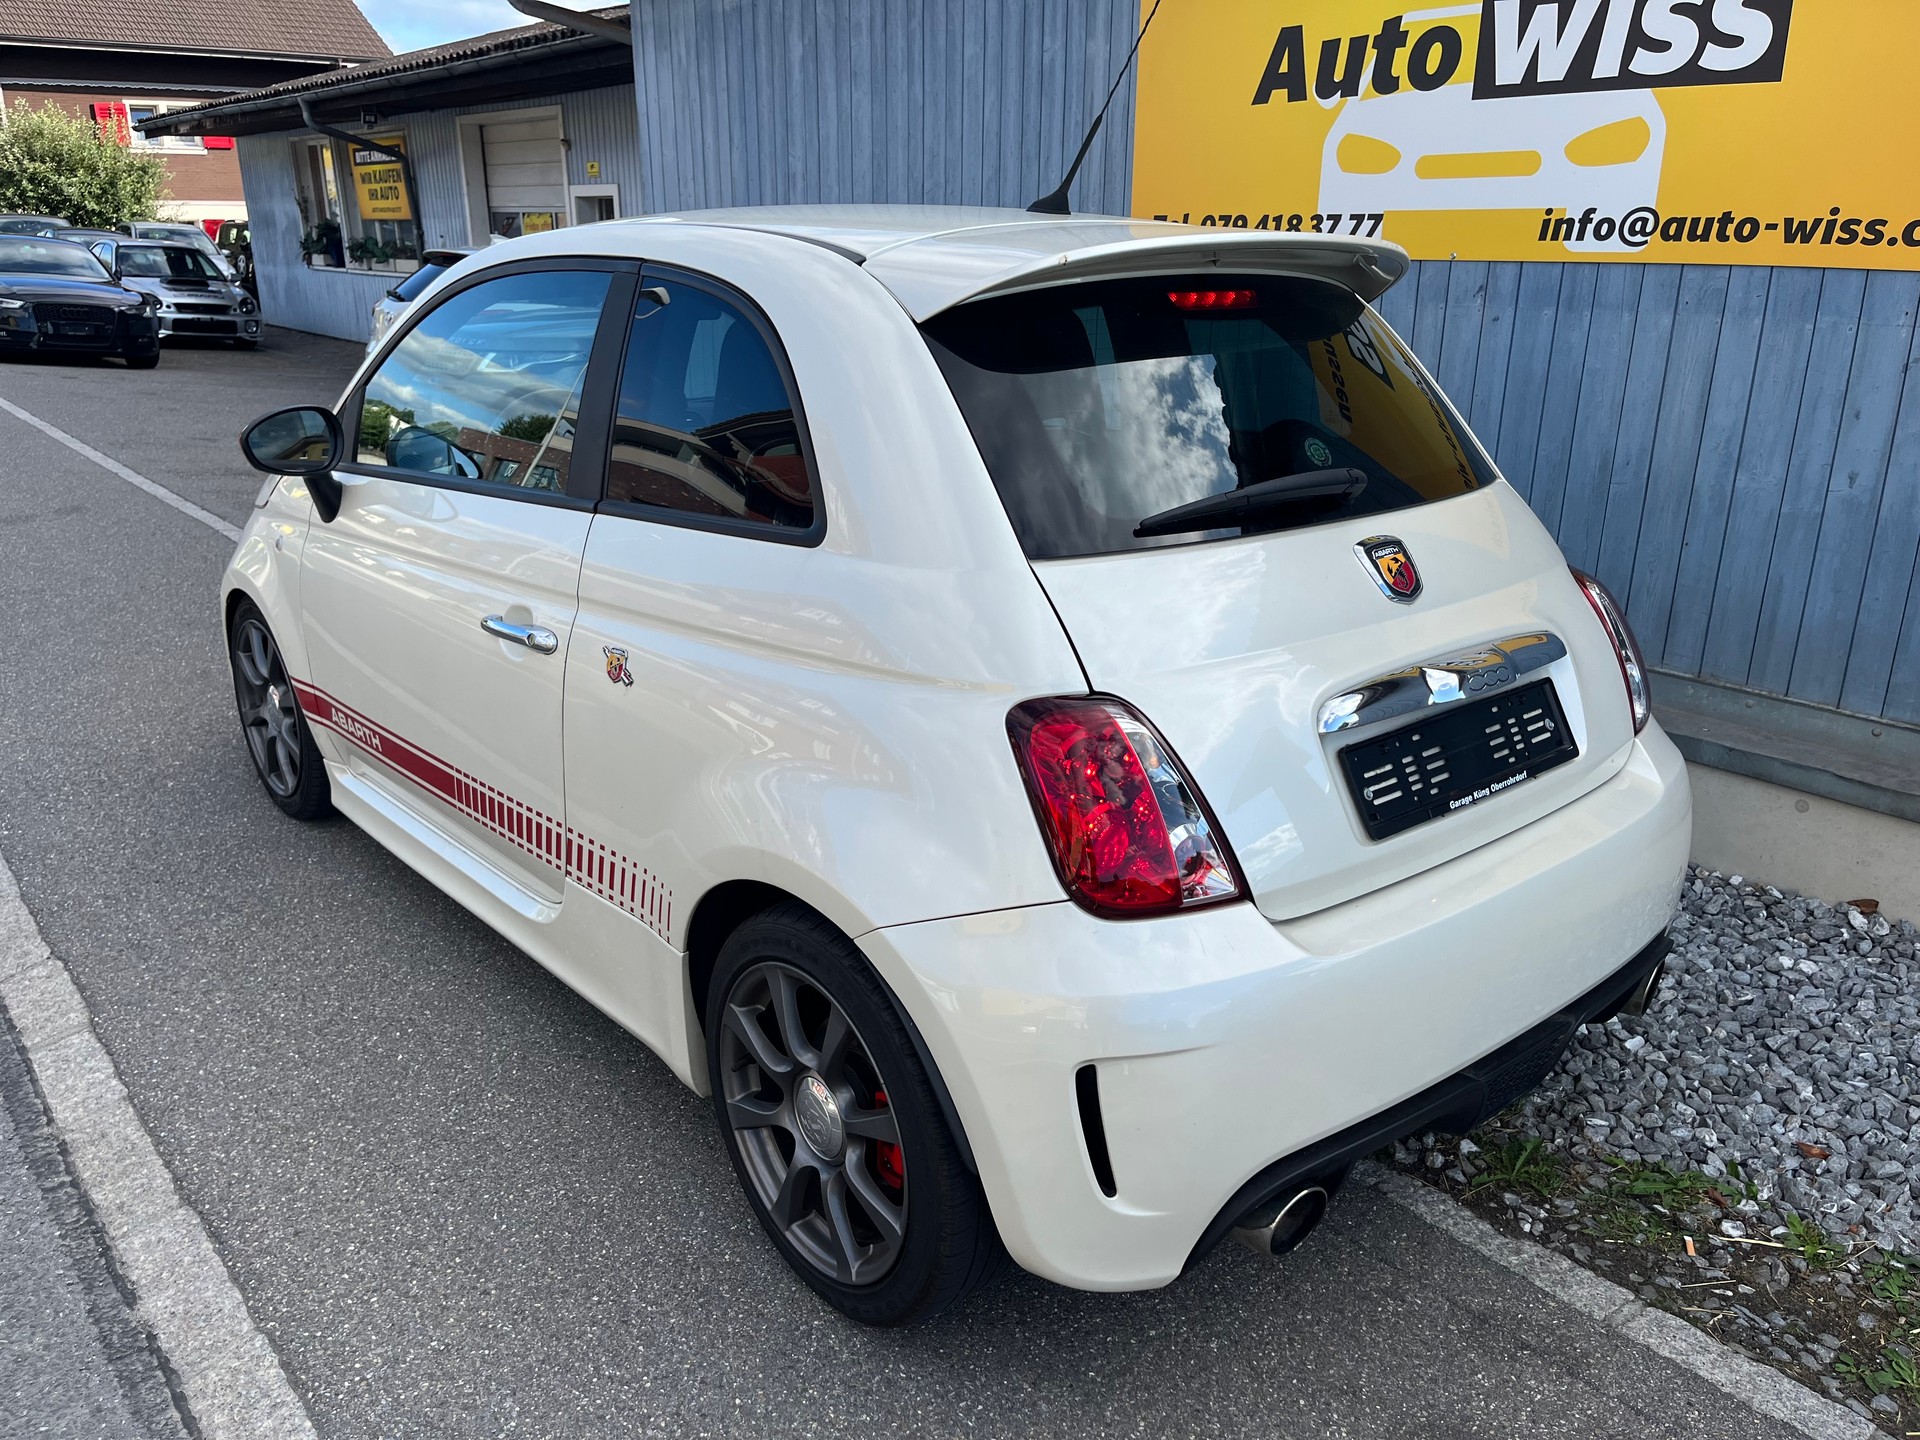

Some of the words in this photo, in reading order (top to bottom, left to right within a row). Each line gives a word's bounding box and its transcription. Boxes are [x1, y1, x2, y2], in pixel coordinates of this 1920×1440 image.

[1251, 15, 1463, 106] Auto
[372, 168, 402, 184] KAUFEN
[380, 186, 400, 200] AUTO
[1254, 214, 1304, 231] 418
[1309, 213, 1343, 233] 37
[1349, 213, 1385, 238] 77
[1375, 547, 1399, 558] ABARTH
[331, 706, 383, 752] ABARTH
[1449, 794, 1473, 809] Garage
[1473, 787, 1491, 800] Küng
[1490, 769, 1528, 793] Oberrohrdorf
